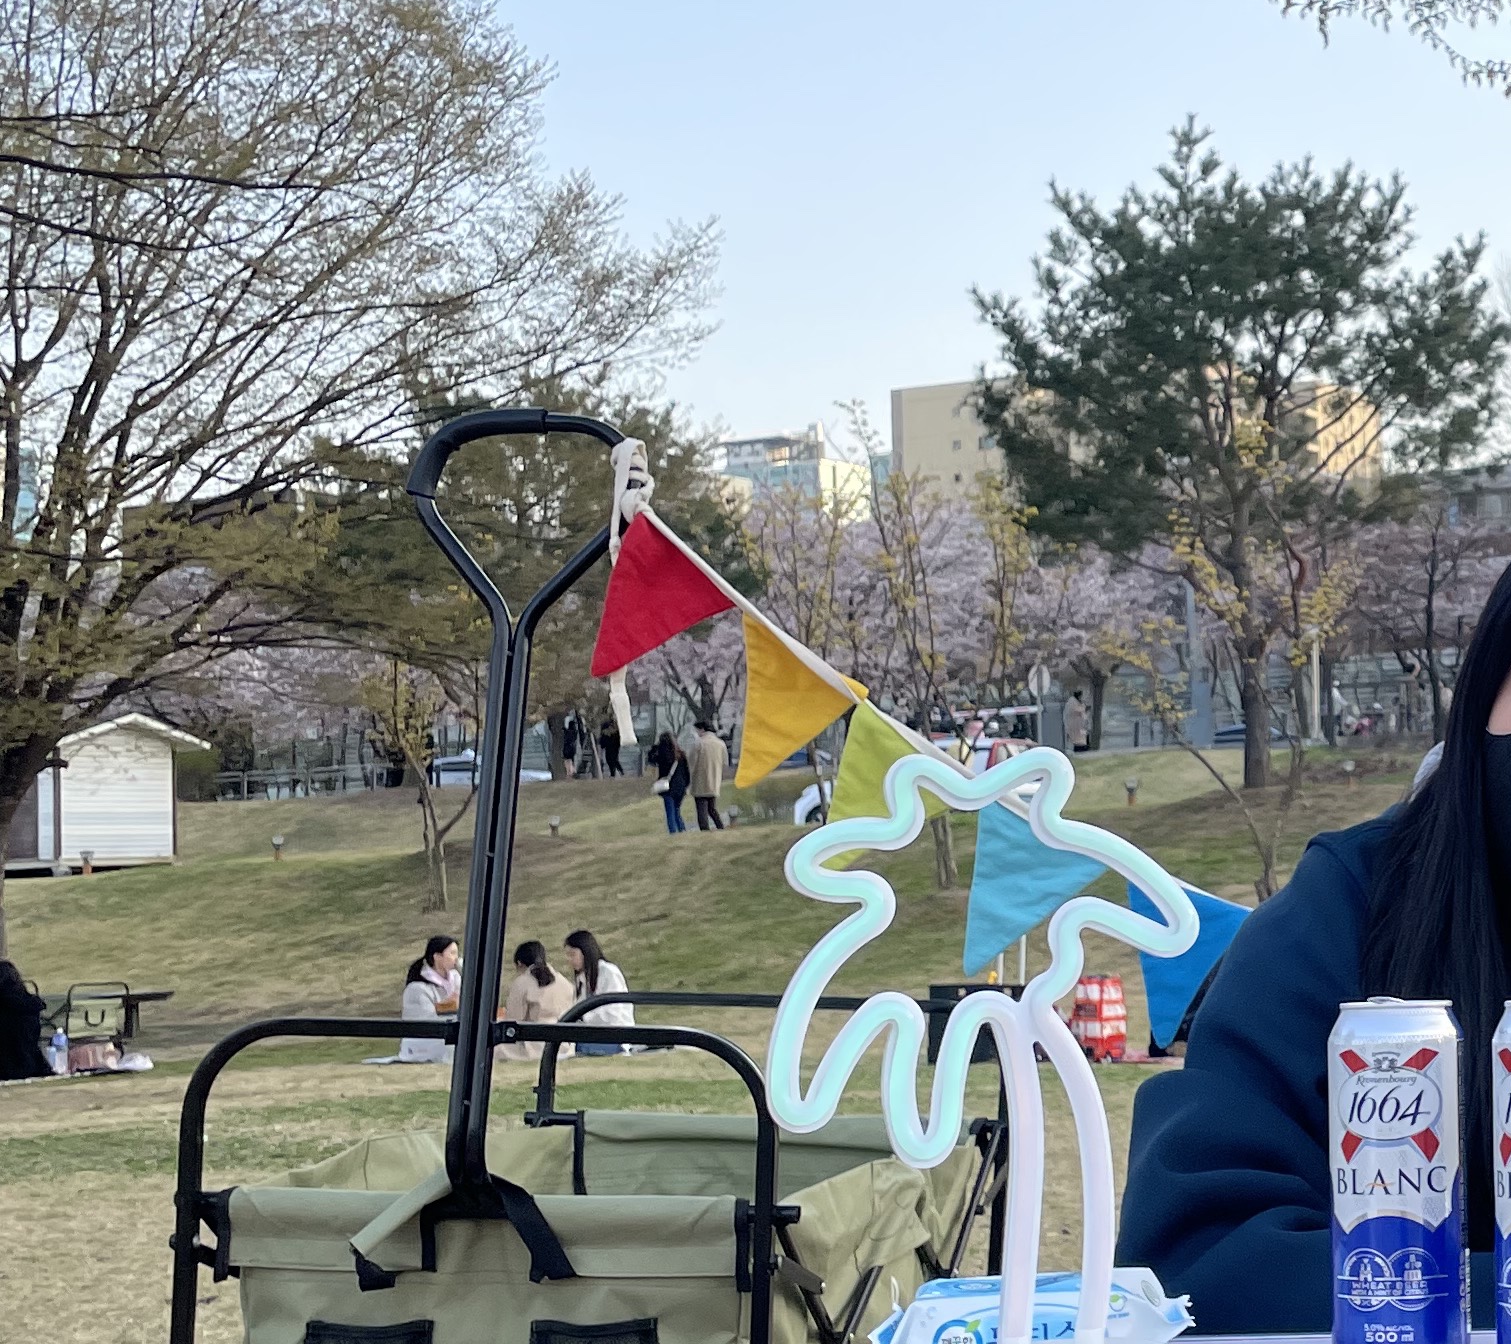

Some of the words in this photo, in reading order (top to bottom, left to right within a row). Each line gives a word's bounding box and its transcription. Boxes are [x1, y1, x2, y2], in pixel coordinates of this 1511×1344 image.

[1356, 1075, 1418, 1088] Kronenbourg
[1348, 1085, 1431, 1127] 1664
[1336, 1165, 1448, 1196] BLANC
[1364, 1331, 1399, 1343] 500
[1400, 1331, 1415, 1343] ml
